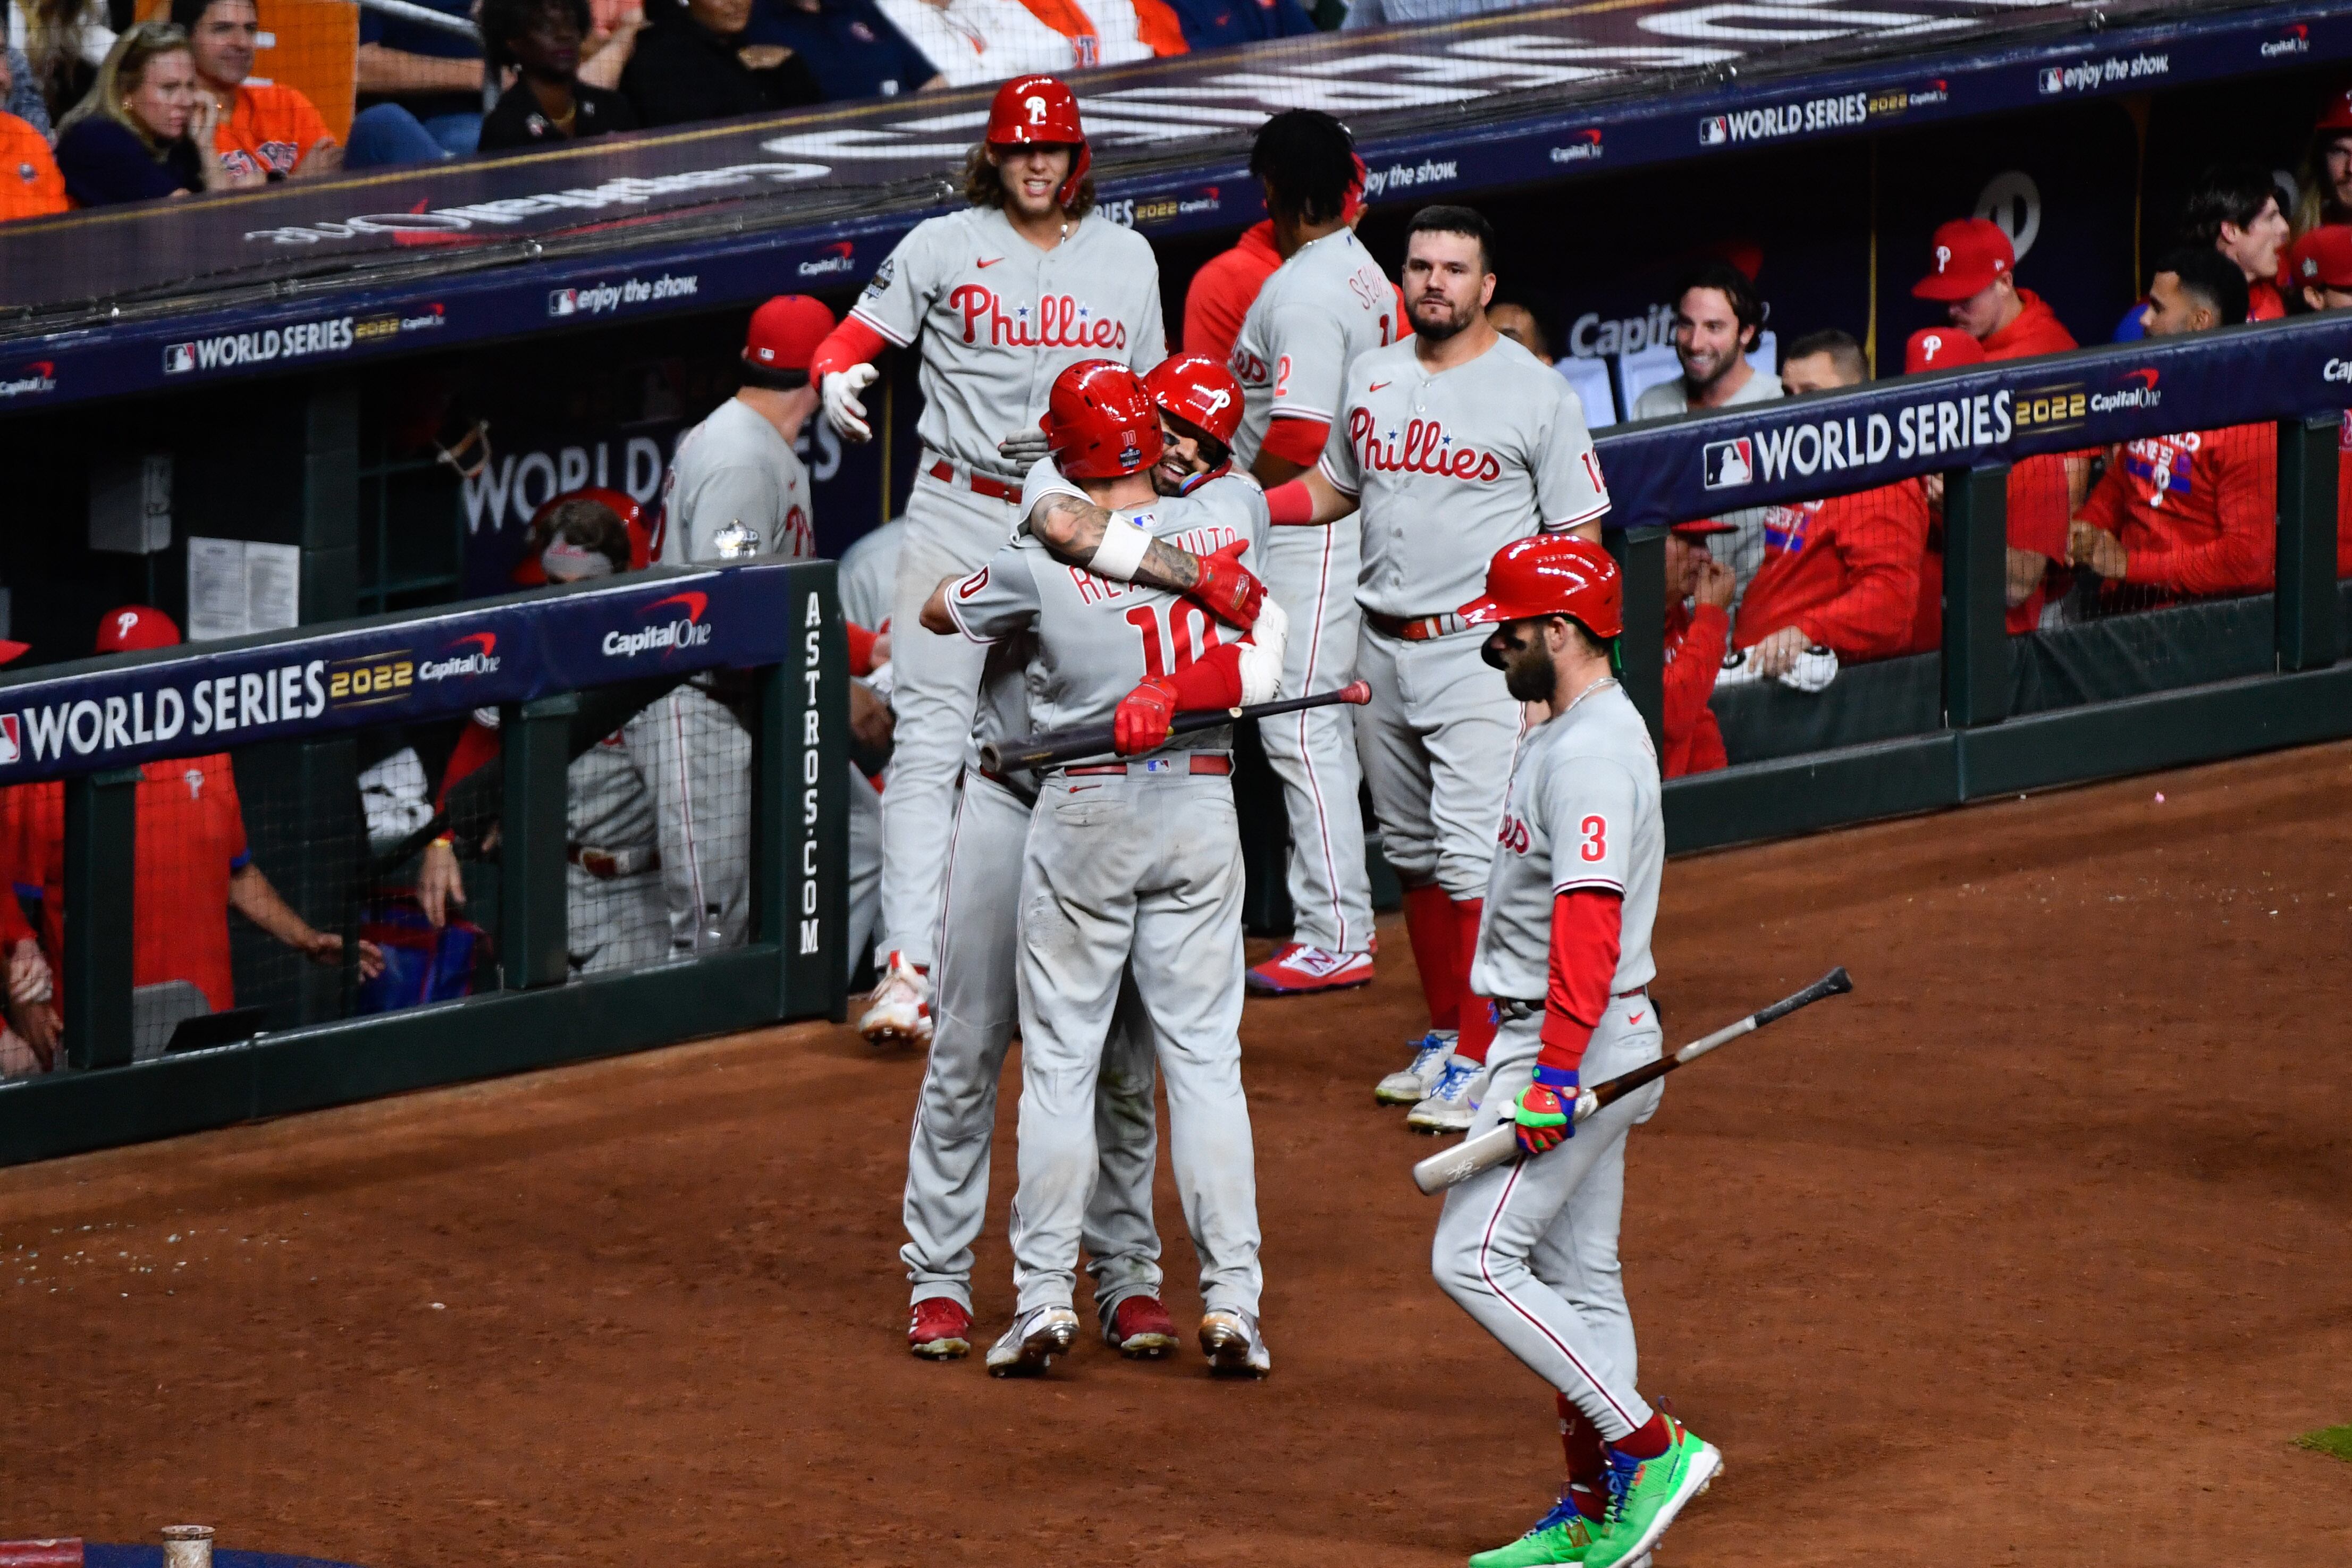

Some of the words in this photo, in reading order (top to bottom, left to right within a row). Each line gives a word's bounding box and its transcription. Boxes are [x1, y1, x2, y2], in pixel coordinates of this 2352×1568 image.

[2064, 61, 2103, 91] enjoy
[2104, 57, 2128, 81] the
[1727, 108, 1802, 141] WORLD
[1805, 92, 1867, 132] SERIES
[1869, 94, 1907, 113] 2022
[1363, 168, 1387, 196] joy
[1387, 164, 1414, 189] the
[1136, 201, 1178, 220] 2022
[1937, 246, 1951, 273] P
[577, 282, 622, 315] enjoy
[624, 277, 651, 303] the
[949, 283, 1126, 351] Phillies
[197, 331, 280, 369] WORLD
[281, 317, 354, 358] SERIES
[355, 318, 400, 338] 2022
[1923, 335, 1942, 362] P
[1205, 389, 1230, 415] P
[1122, 429, 1136, 446] 10
[1348, 406, 1501, 482] Phillies
[1755, 417, 1892, 482] WORLD
[1898, 389, 2012, 460] SERIES
[2015, 392, 2086, 426] 2022
[1120, 449, 1141, 458] WORLD
[117, 612, 138, 639] P
[1125, 594, 1223, 678] 10
[23, 687, 185, 762] WORLD
[192, 659, 326, 736] SERIES
[330, 661, 414, 698] 2022
[184, 769, 205, 800] P
[1581, 813, 1607, 863] 3
